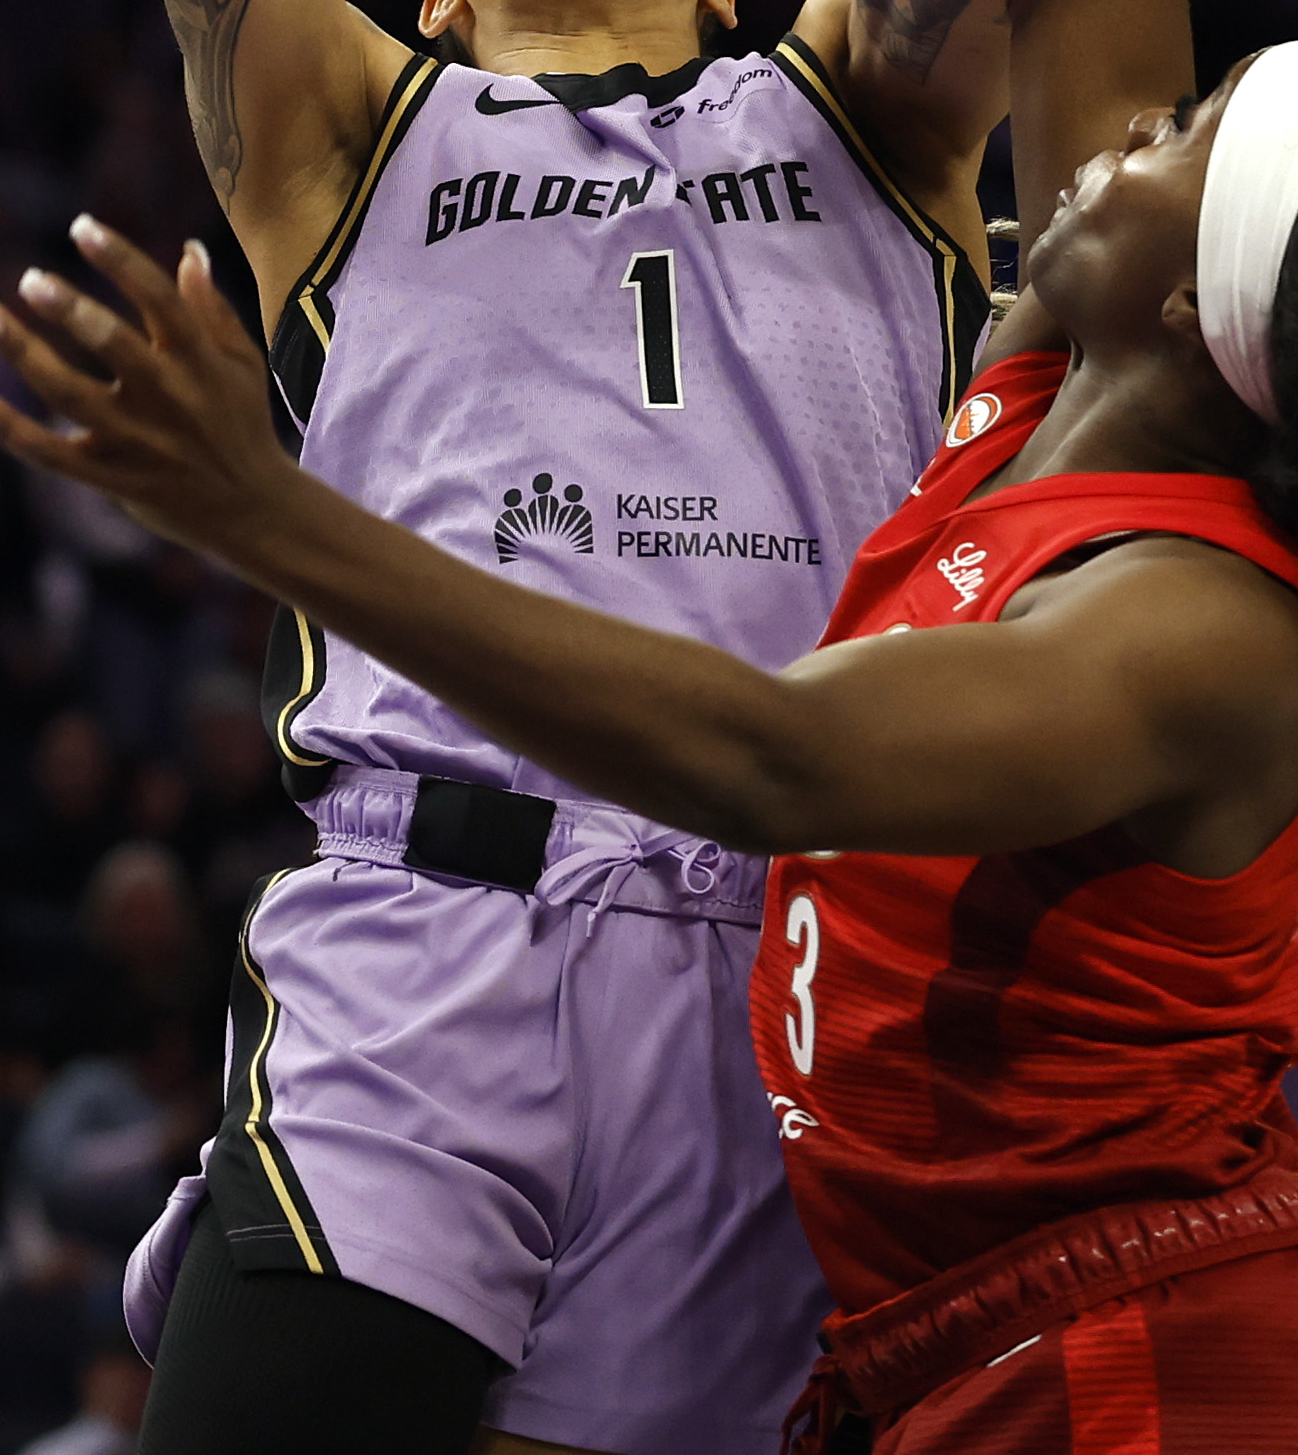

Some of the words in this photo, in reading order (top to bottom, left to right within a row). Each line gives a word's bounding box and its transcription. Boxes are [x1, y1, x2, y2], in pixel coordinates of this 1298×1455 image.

[425, 164, 655, 246] GOLDEN
[620, 248, 685, 410] 1
[616, 494, 718, 521] KAISER
[616, 530, 822, 565] PERMANENTE
[937, 542, 988, 612] Lilly
[785, 896, 820, 1077] 3
